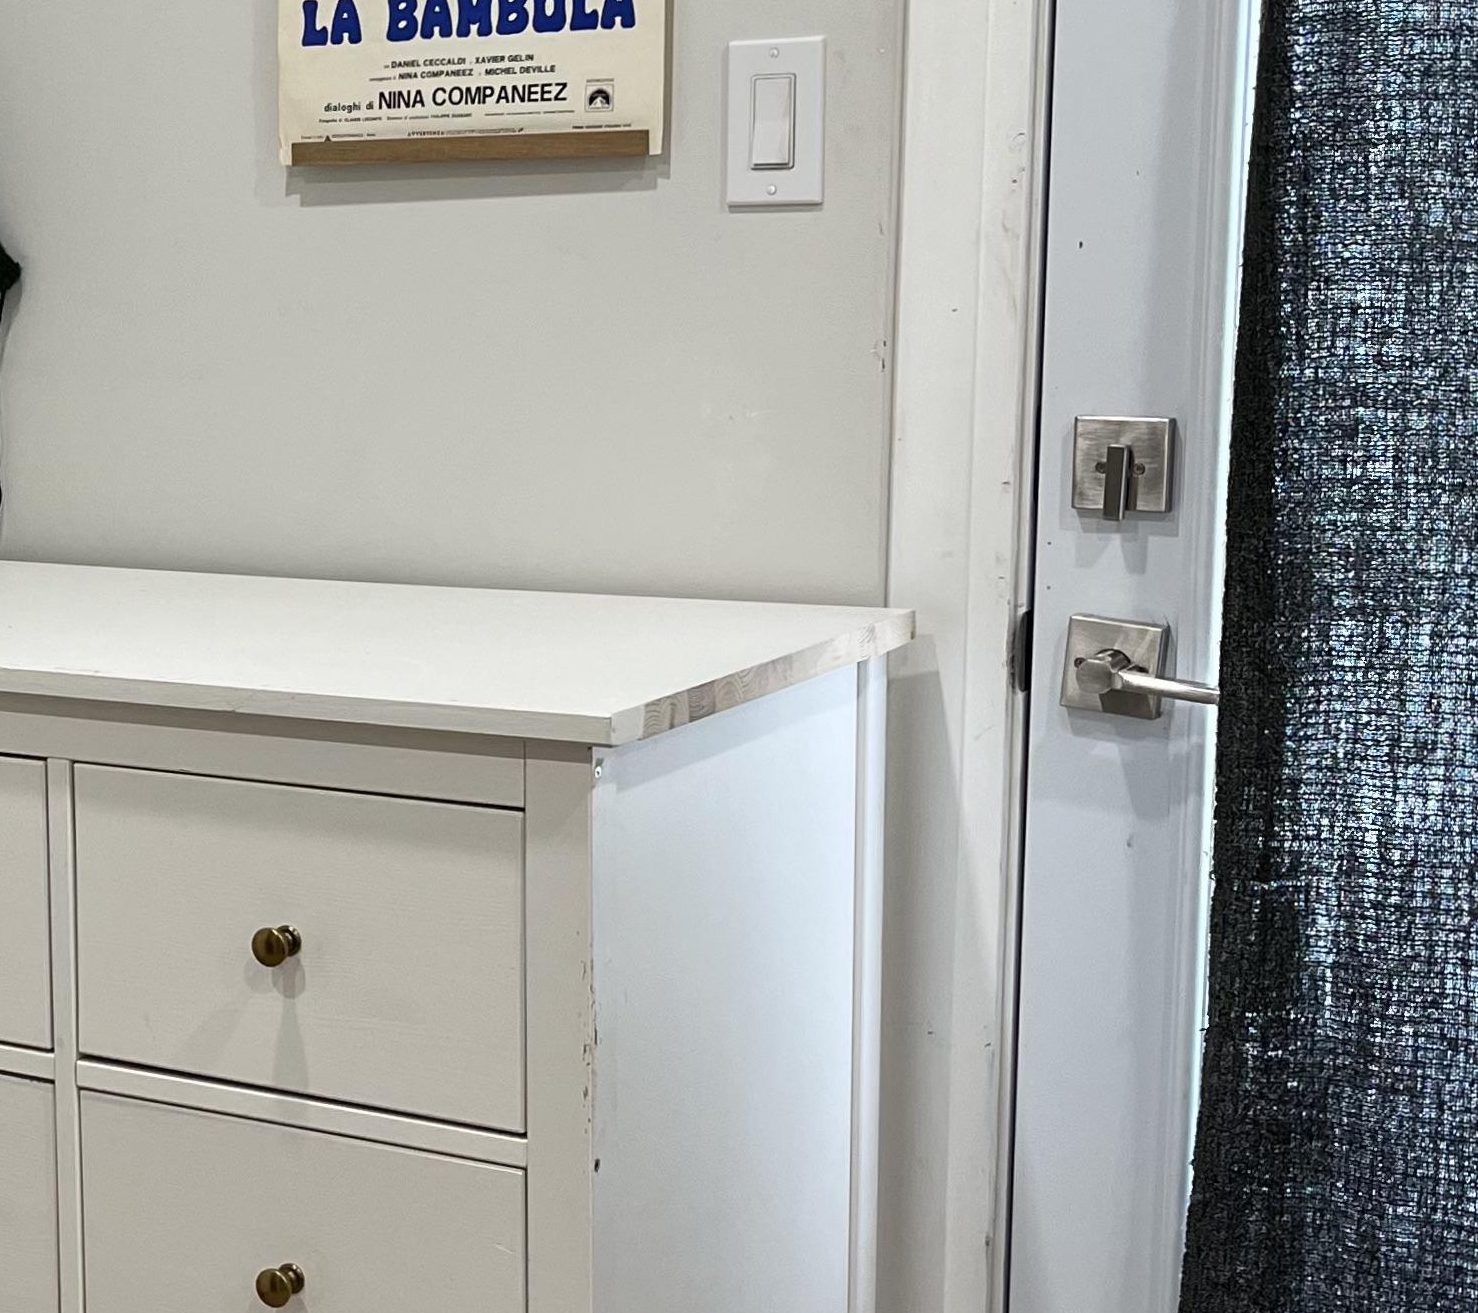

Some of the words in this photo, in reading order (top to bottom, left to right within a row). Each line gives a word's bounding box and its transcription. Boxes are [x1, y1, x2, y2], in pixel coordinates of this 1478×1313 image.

[391, 59, 421, 69] DANIEL
[423, 57, 467, 67] CECCALDI
[475, 55, 505, 65] XAVIER
[507, 54, 534, 63] GELIN
[398, 70, 418, 80] NINA
[420, 68, 474, 79] COMPANEEZ
[485, 67, 517, 76] MICHEL
[519, 65, 556, 75] DEVILLE
[324, 102, 361, 114] dialoghi
[365, 101, 374, 110] di
[378, 89, 425, 110] NINA
[432, 82, 568, 107] COMPANEEZ
